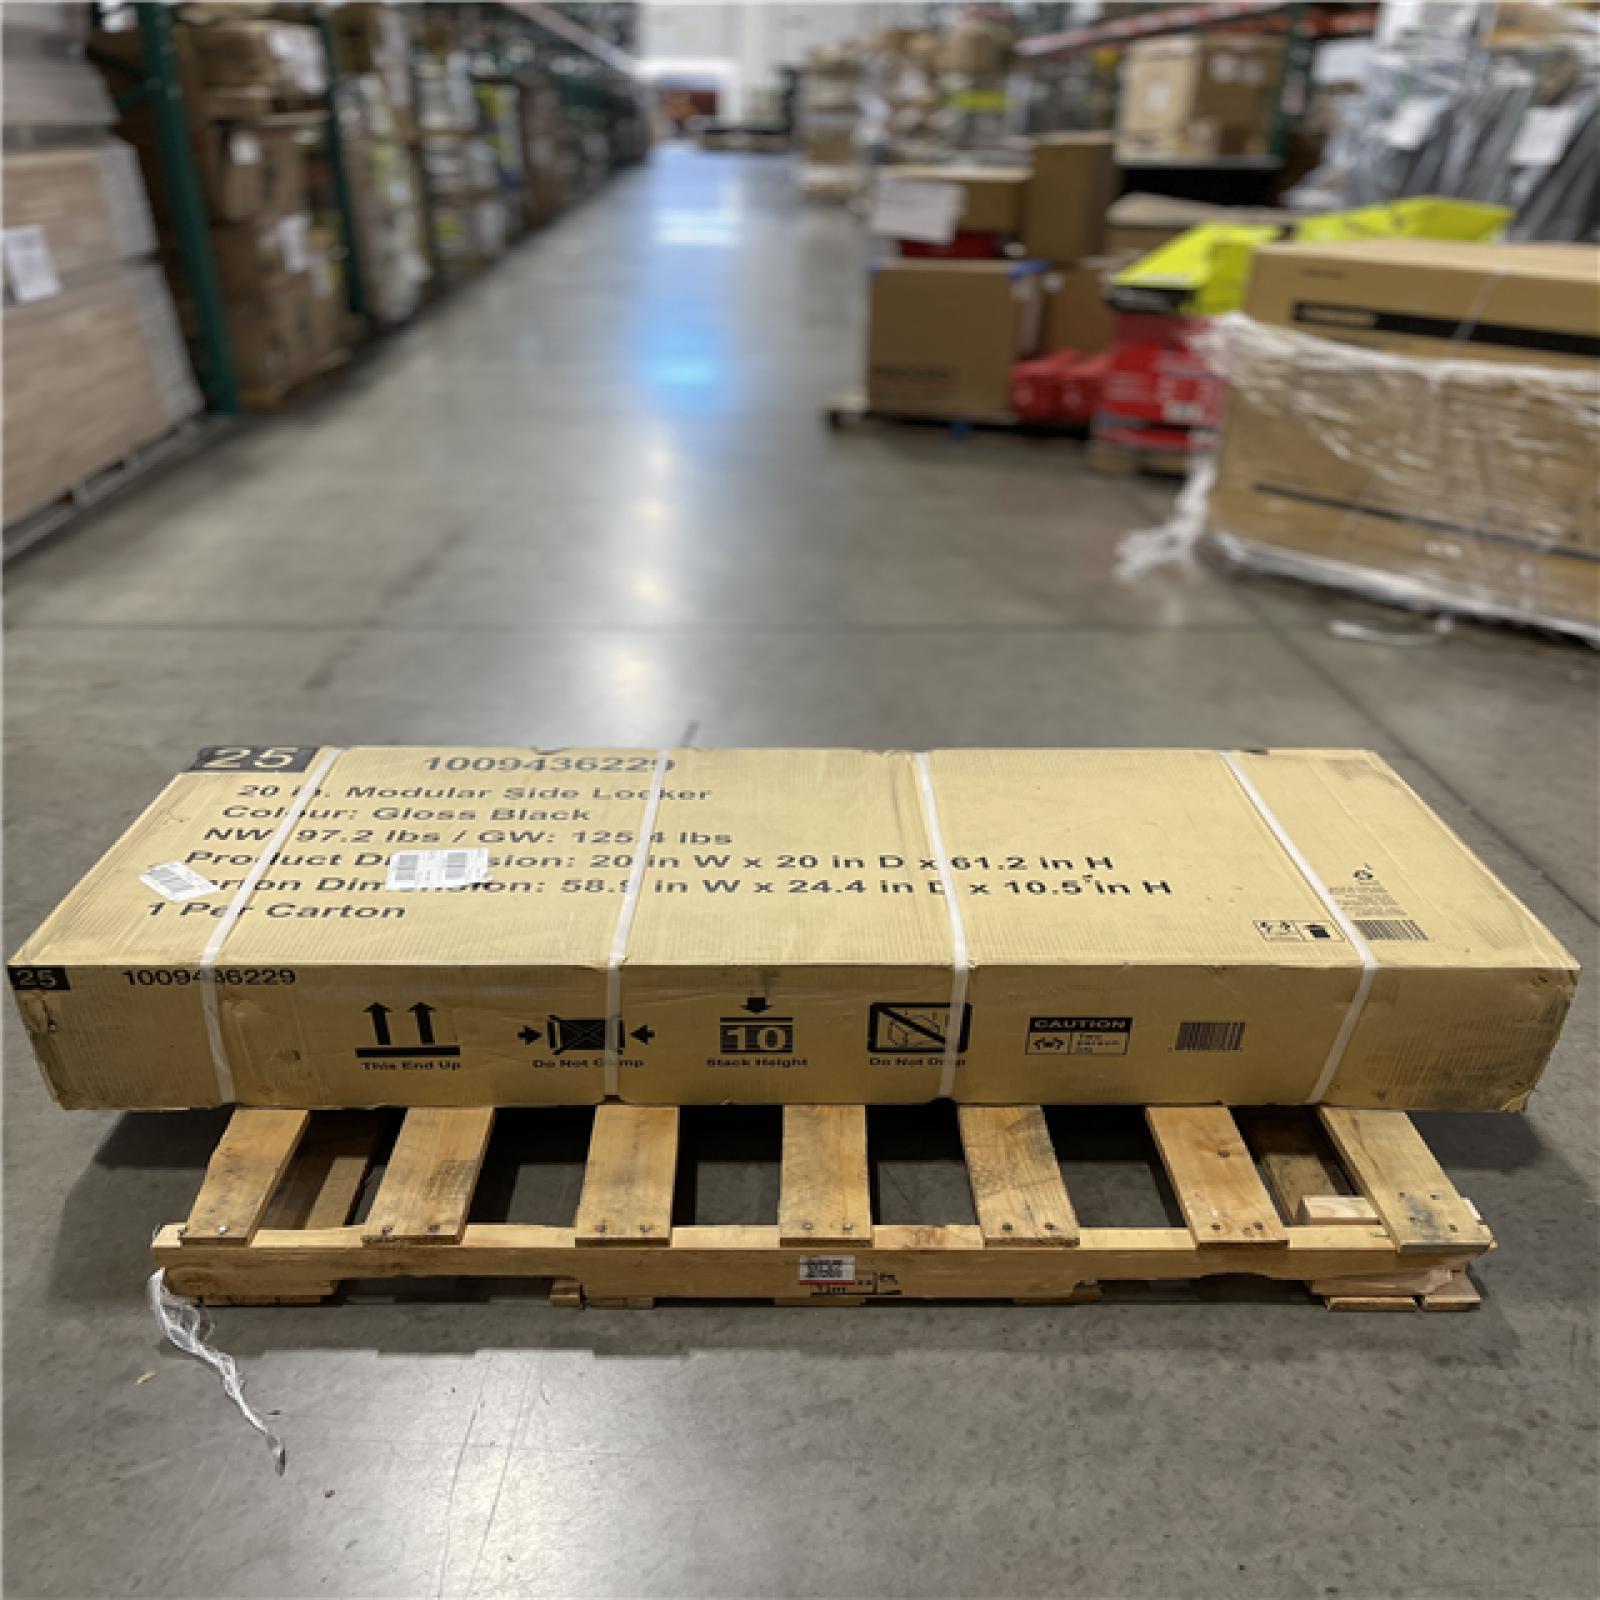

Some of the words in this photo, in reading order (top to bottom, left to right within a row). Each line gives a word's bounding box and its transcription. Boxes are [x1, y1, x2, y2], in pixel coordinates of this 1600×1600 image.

[201, 746, 300, 769] 25
[425, 756, 676, 773] 1009436229
[237, 784, 281, 797] 20
[346, 786, 492, 799] Modular
[504, 786, 579, 800] Side
[592, 786, 712, 801] Locker
[372, 806, 476, 821] Gloss
[490, 807, 591, 821] Black
[297, 828, 374, 842] 97.2
[385, 829, 440, 843] lbs
[451, 829, 468, 843] /
[477, 830, 556, 843] GW:
[680, 831, 733, 845] lbs
[354, 853, 576, 869] Dsion:
[589, 854, 634, 869] 20
[648, 854, 680, 868] in
[693, 854, 731, 868] W
[743, 857, 762, 868] x
[776, 854, 819, 869] 20
[832, 854, 866, 869] in
[879, 855, 904, 869] D
[919, 858, 938, 870] x
[951, 856, 1029, 871] 61.2
[1039, 856, 1074, 870] in
[1085, 856, 1114, 870] H
[655, 879, 689, 894] in
[702, 879, 740, 894] W
[754, 882, 774, 894] x
[787, 879, 868, 894] 24.4
[880, 879, 914, 894] in
[969, 884, 990, 896] x
[1004, 880, 1083, 895] 10.5
[1094, 880, 1131, 895] in
[1142, 880, 1173, 895] H
[149, 902, 166, 917] 1
[180, 902, 254, 918] Per
[265, 903, 407, 919] Carton
[15, 969, 57, 987] 25
[1034, 1018, 1127, 1030] CAUTION
[726, 1026, 787, 1050] 10
[361, 1060, 397, 1071] This
[402, 1060, 434, 1070] End
[438, 1060, 462, 1072] Up
[532, 1059, 556, 1069] Do
[560, 1058, 589, 1069] Not
[592, 1058, 644, 1070] Cmp
[706, 1057, 750, 1068] Stack
[755, 1057, 809, 1068] Height
[869, 1057, 891, 1067] Do
[894, 1057, 924, 1067] Not
[927, 1057, 967, 1070] Drp
